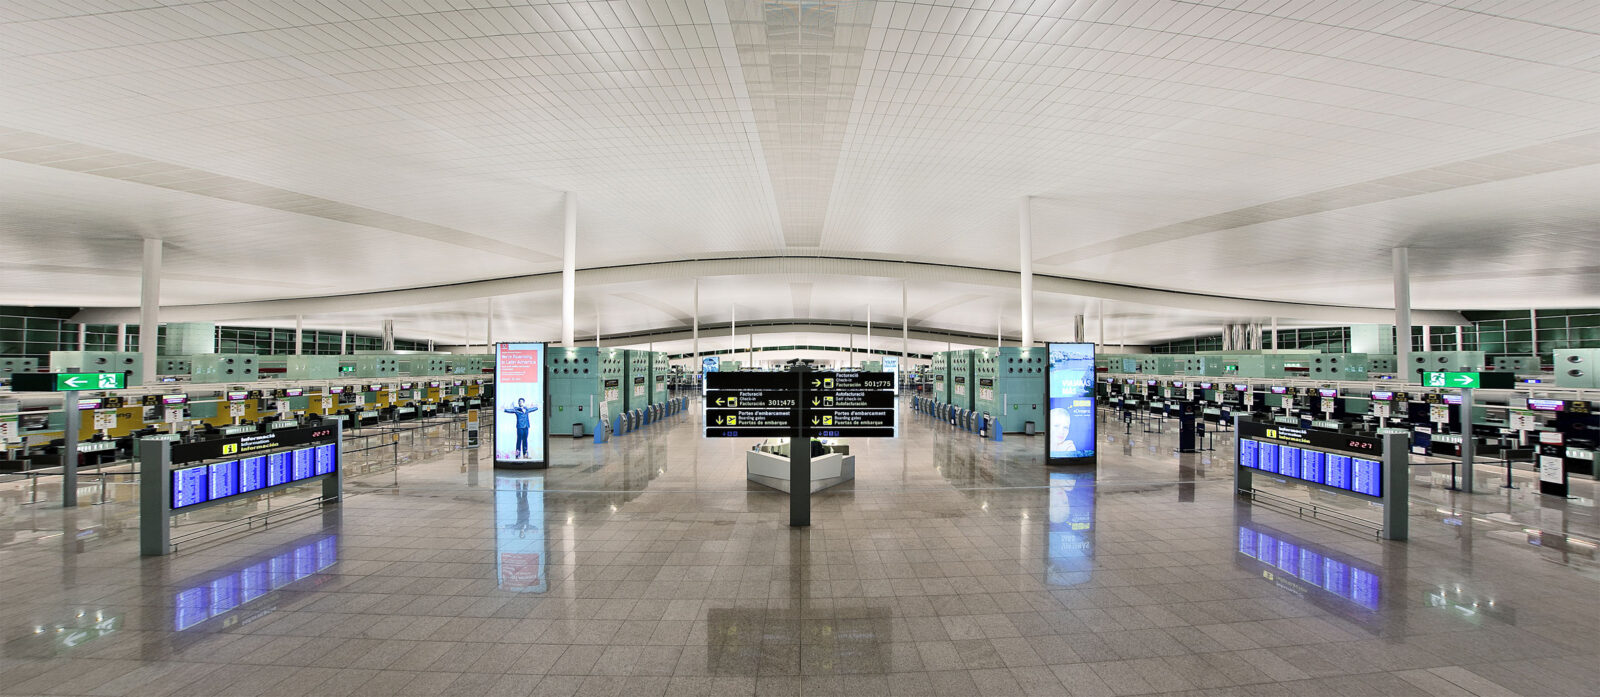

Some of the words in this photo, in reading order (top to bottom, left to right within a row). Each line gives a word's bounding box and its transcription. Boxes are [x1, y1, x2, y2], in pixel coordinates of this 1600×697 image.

[241, 433, 275, 442] Informació
[1279, 435, 1310, 444] Información
[241, 442, 279, 452] Información
